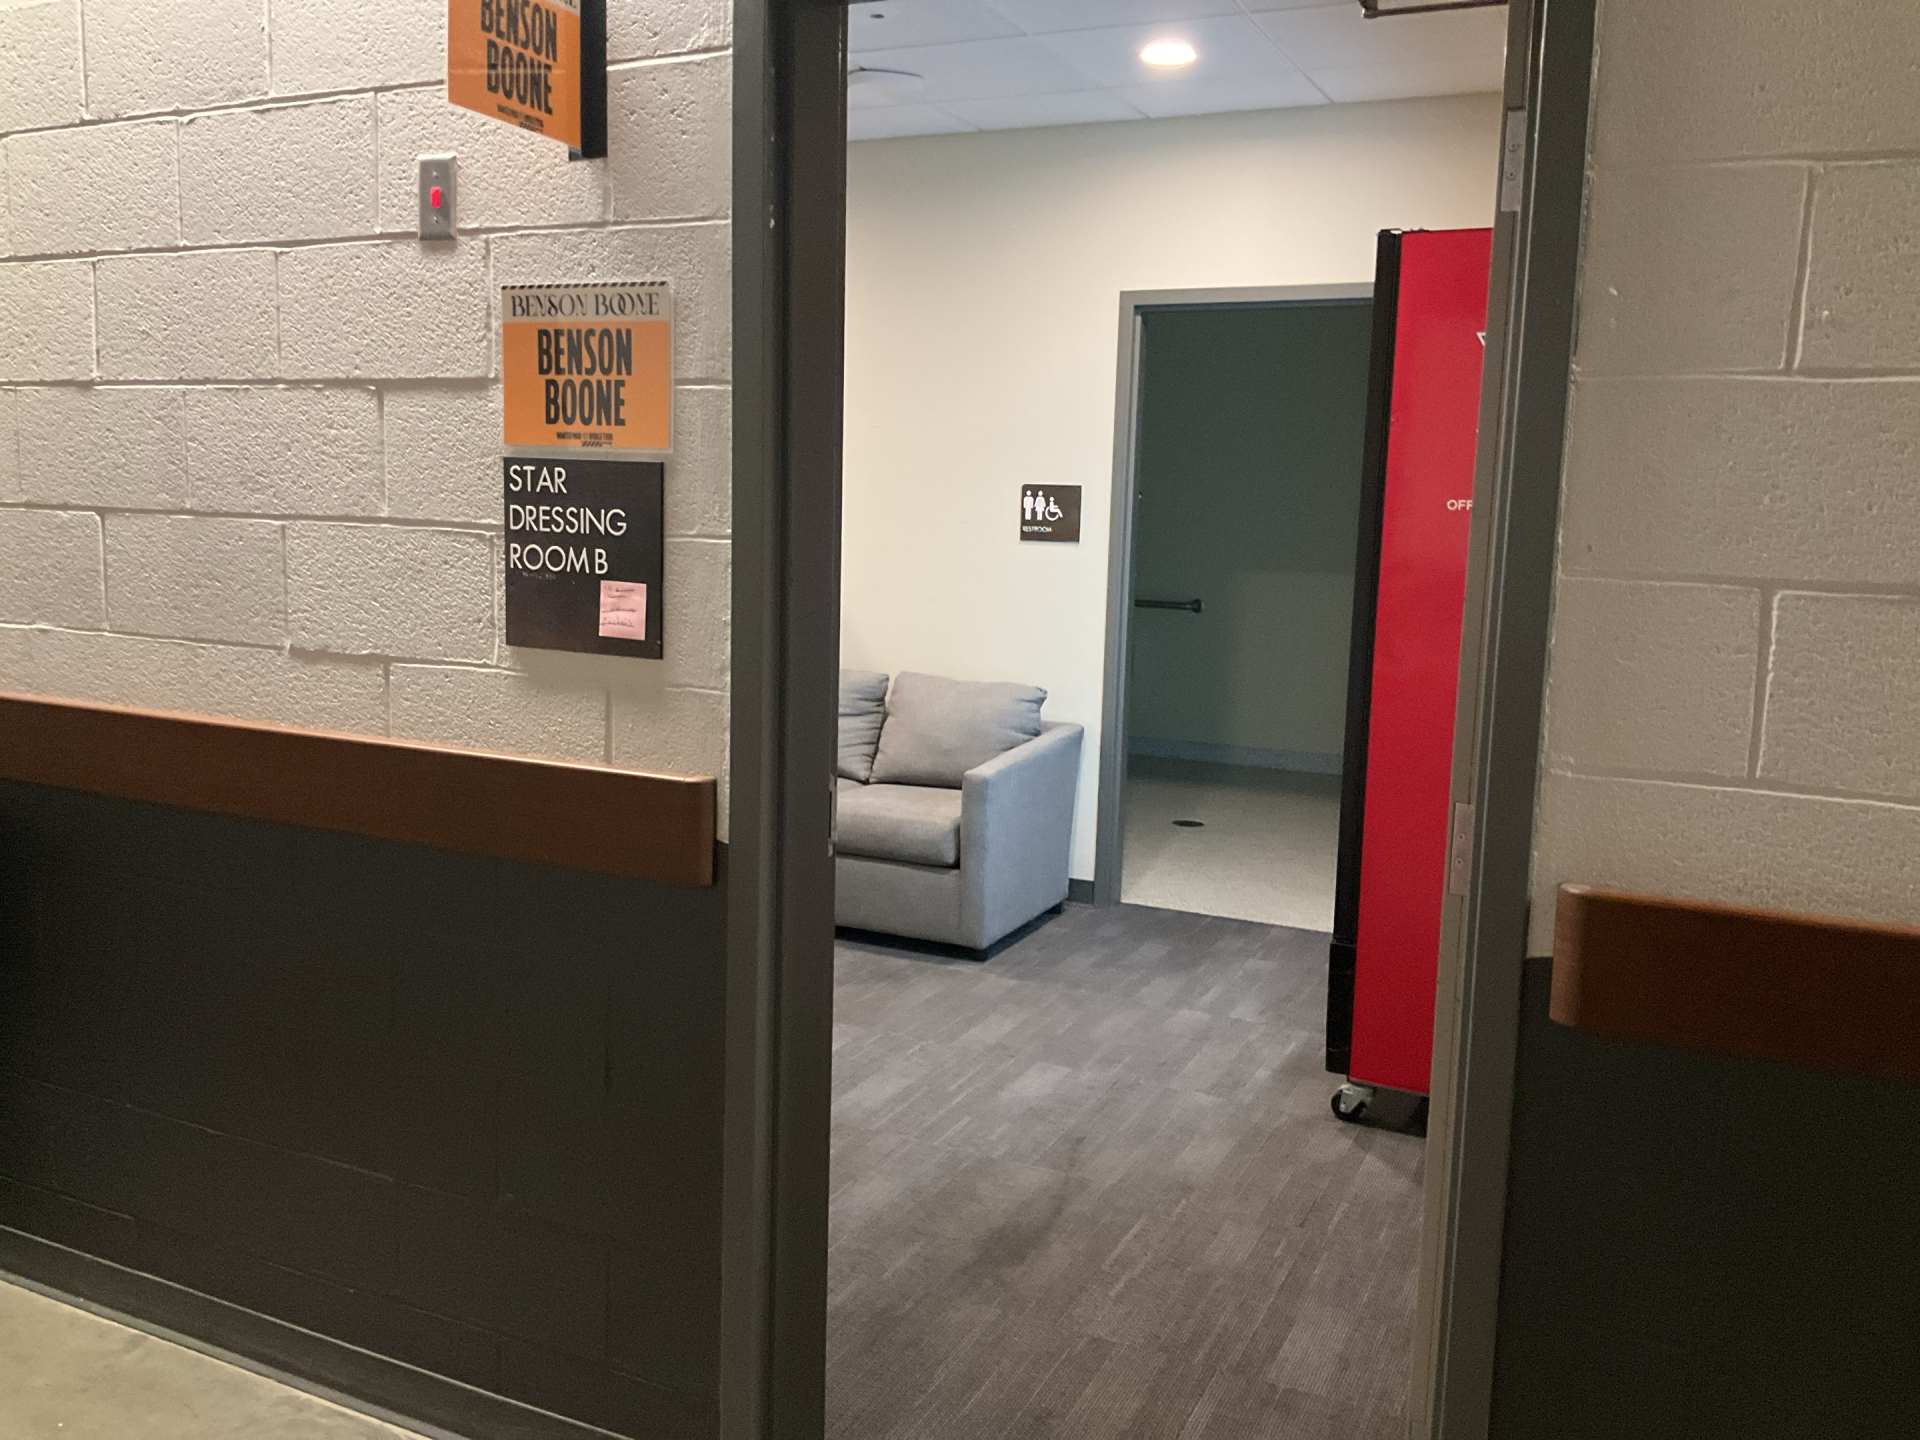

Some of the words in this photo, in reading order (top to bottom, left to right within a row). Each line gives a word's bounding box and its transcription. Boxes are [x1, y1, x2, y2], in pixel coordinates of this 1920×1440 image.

[481, 0, 557, 63] BENSON
[486, 38, 553, 116] BOONE
[511, 294, 588, 318] BENSON
[595, 292, 660, 317] BOONE
[537, 327, 633, 377] BENSON
[545, 378, 626, 427] BOONE
[509, 465, 568, 494] STAR
[509, 504, 627, 536] DRESSING
[509, 543, 590, 574] ROOM
[594, 548, 609, 575] B
